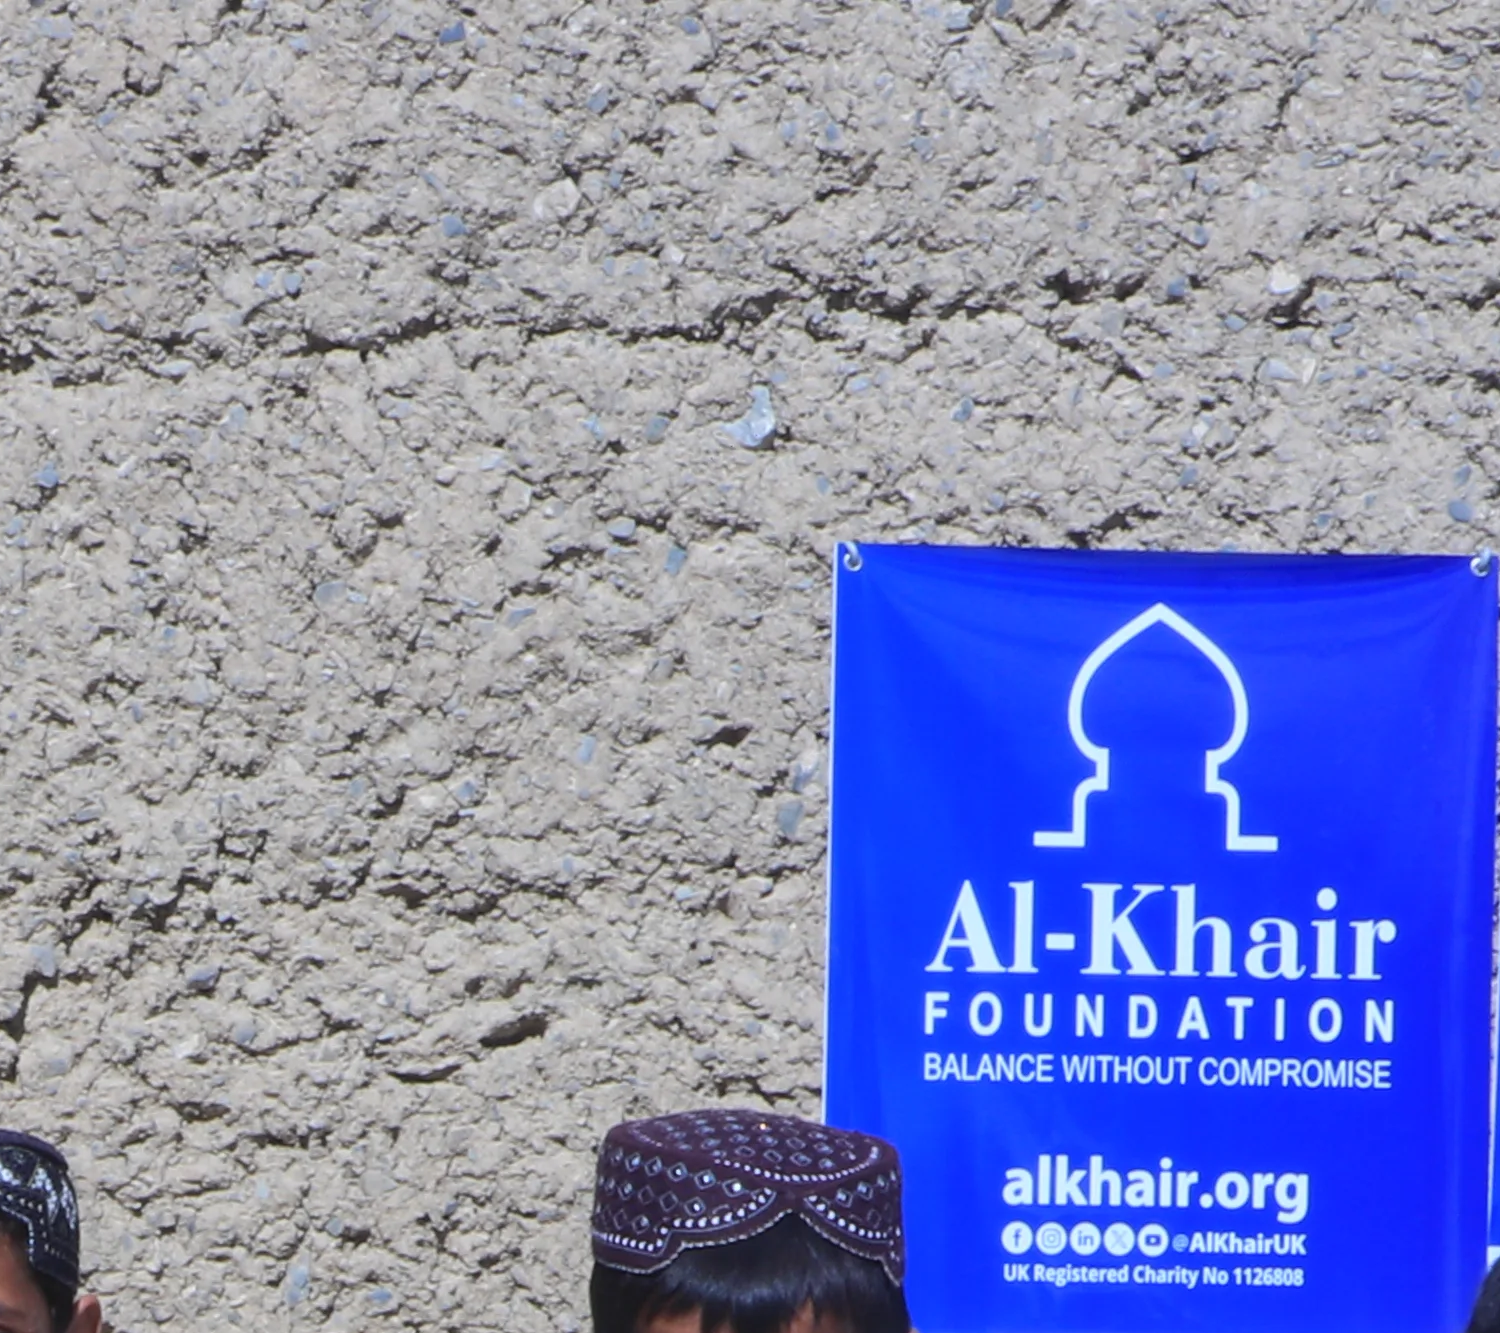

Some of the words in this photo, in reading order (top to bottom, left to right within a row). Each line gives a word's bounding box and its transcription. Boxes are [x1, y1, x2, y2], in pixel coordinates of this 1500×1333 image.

[925, 879, 1396, 981] Al-Khair
[924, 991, 1393, 1043] FOUNDATION
[924, 1053, 1053, 1082] BALANCE
[1062, 1055, 1192, 1085] WITHOUT
[1199, 1057, 1391, 1088] COMPROMISE
[1002, 1154, 1308, 1223] alkhair.org
[1172, 1232, 1307, 1255] @AlKhairUK
[1003, 1264, 1029, 1282] UK
[1034, 1264, 1128, 1287] Registered
[1132, 1266, 1199, 1289] Charity
[1203, 1267, 1228, 1285] No
[1233, 1268, 1304, 1286] 1126808
